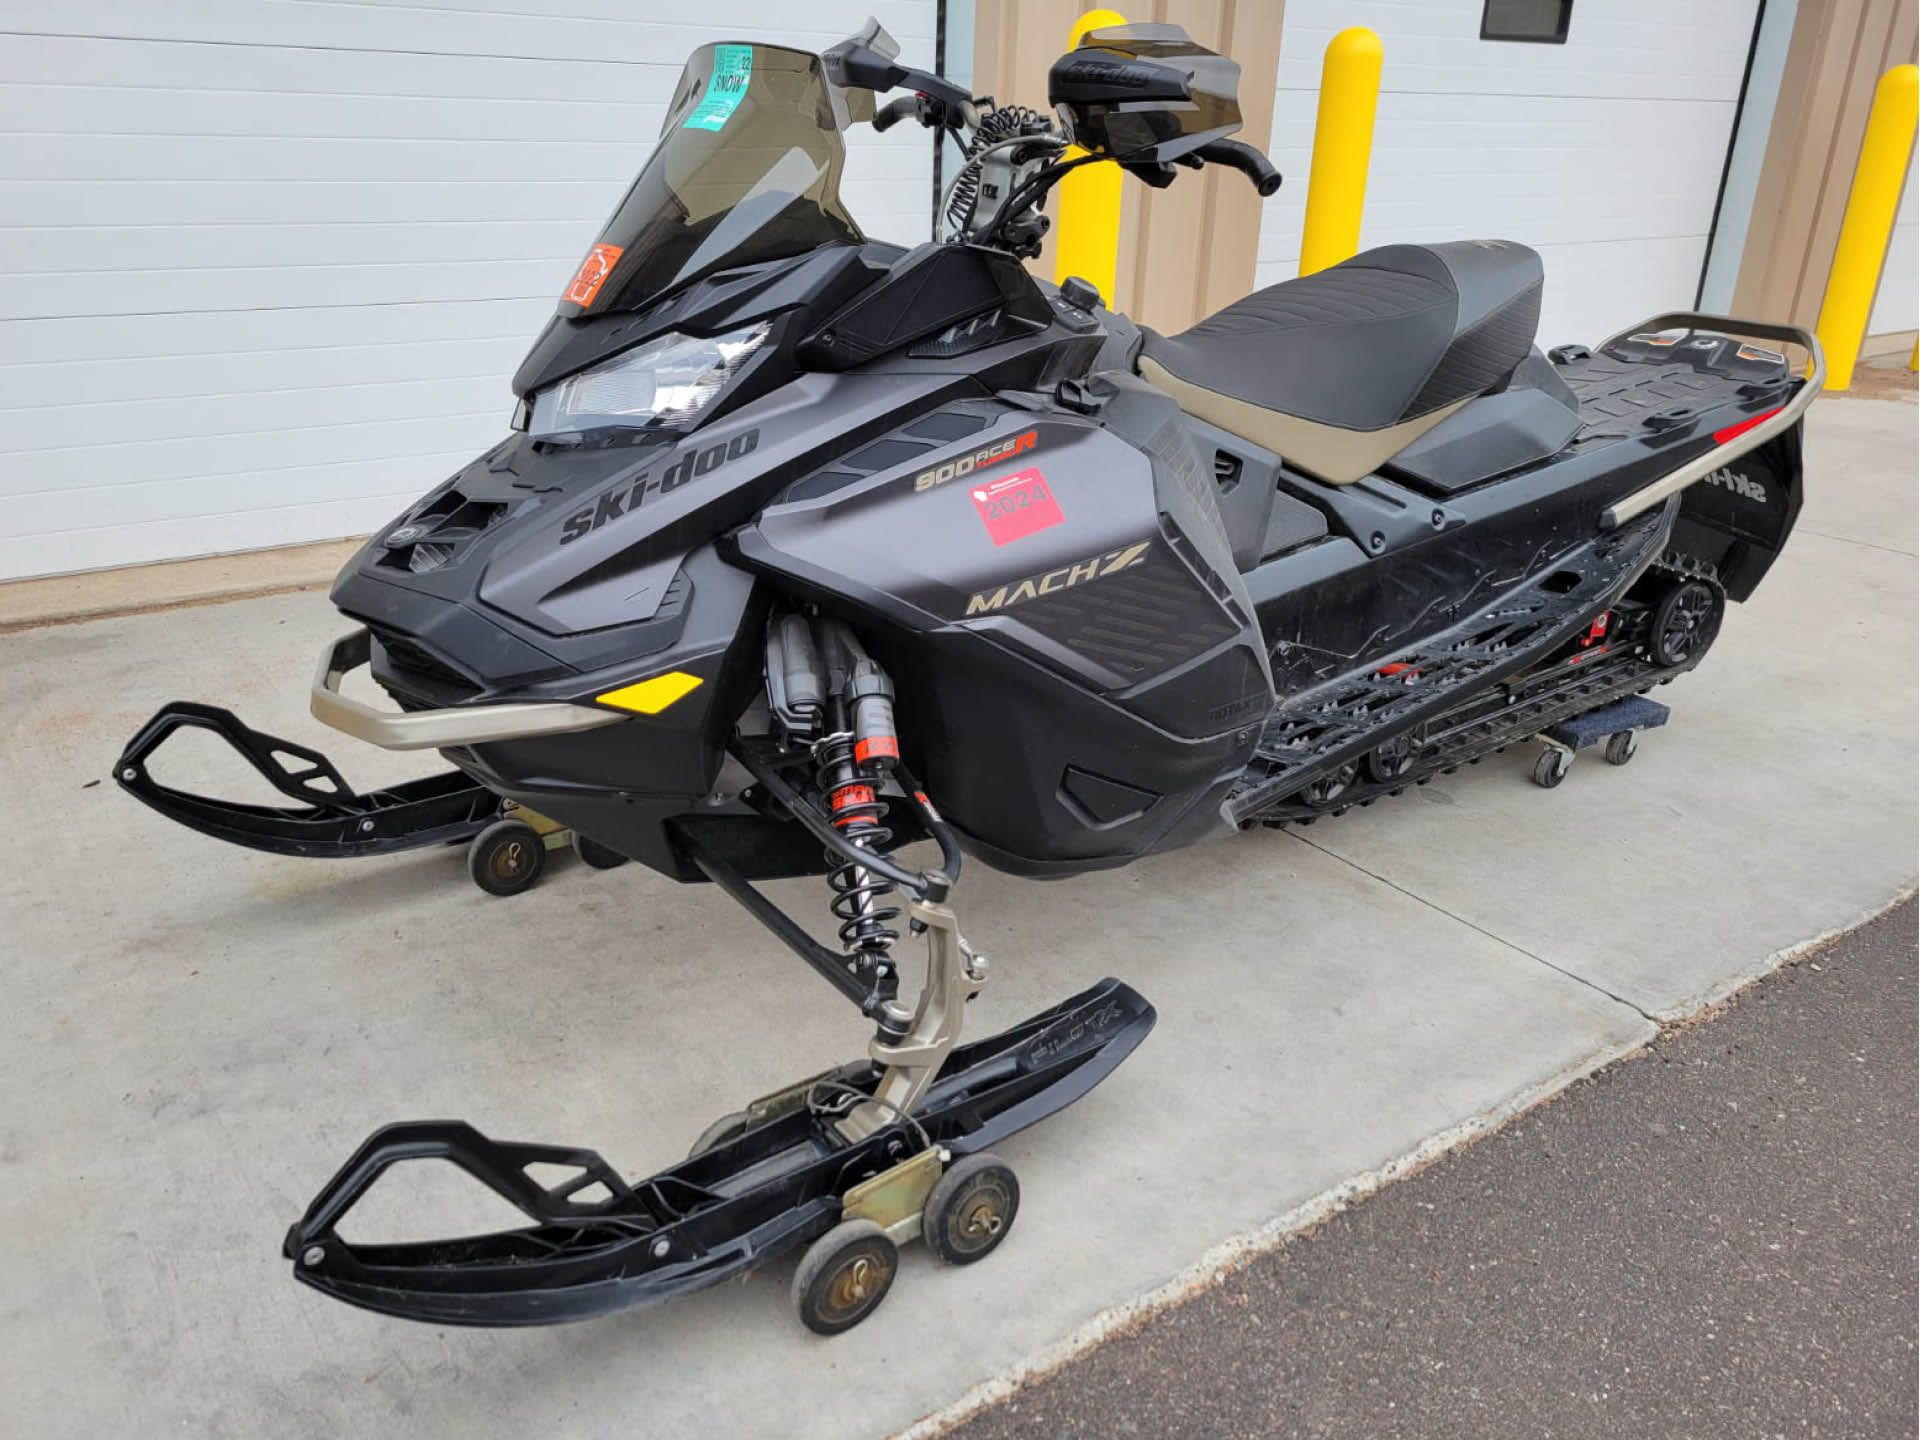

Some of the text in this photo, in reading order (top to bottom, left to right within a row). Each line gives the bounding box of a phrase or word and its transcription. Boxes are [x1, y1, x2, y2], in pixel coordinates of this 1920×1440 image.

[713, 74, 746, 94] SNOW
[915, 455, 975, 492] 900
[975, 440, 1016, 463] ACE
[984, 484, 1048, 520] 2024
